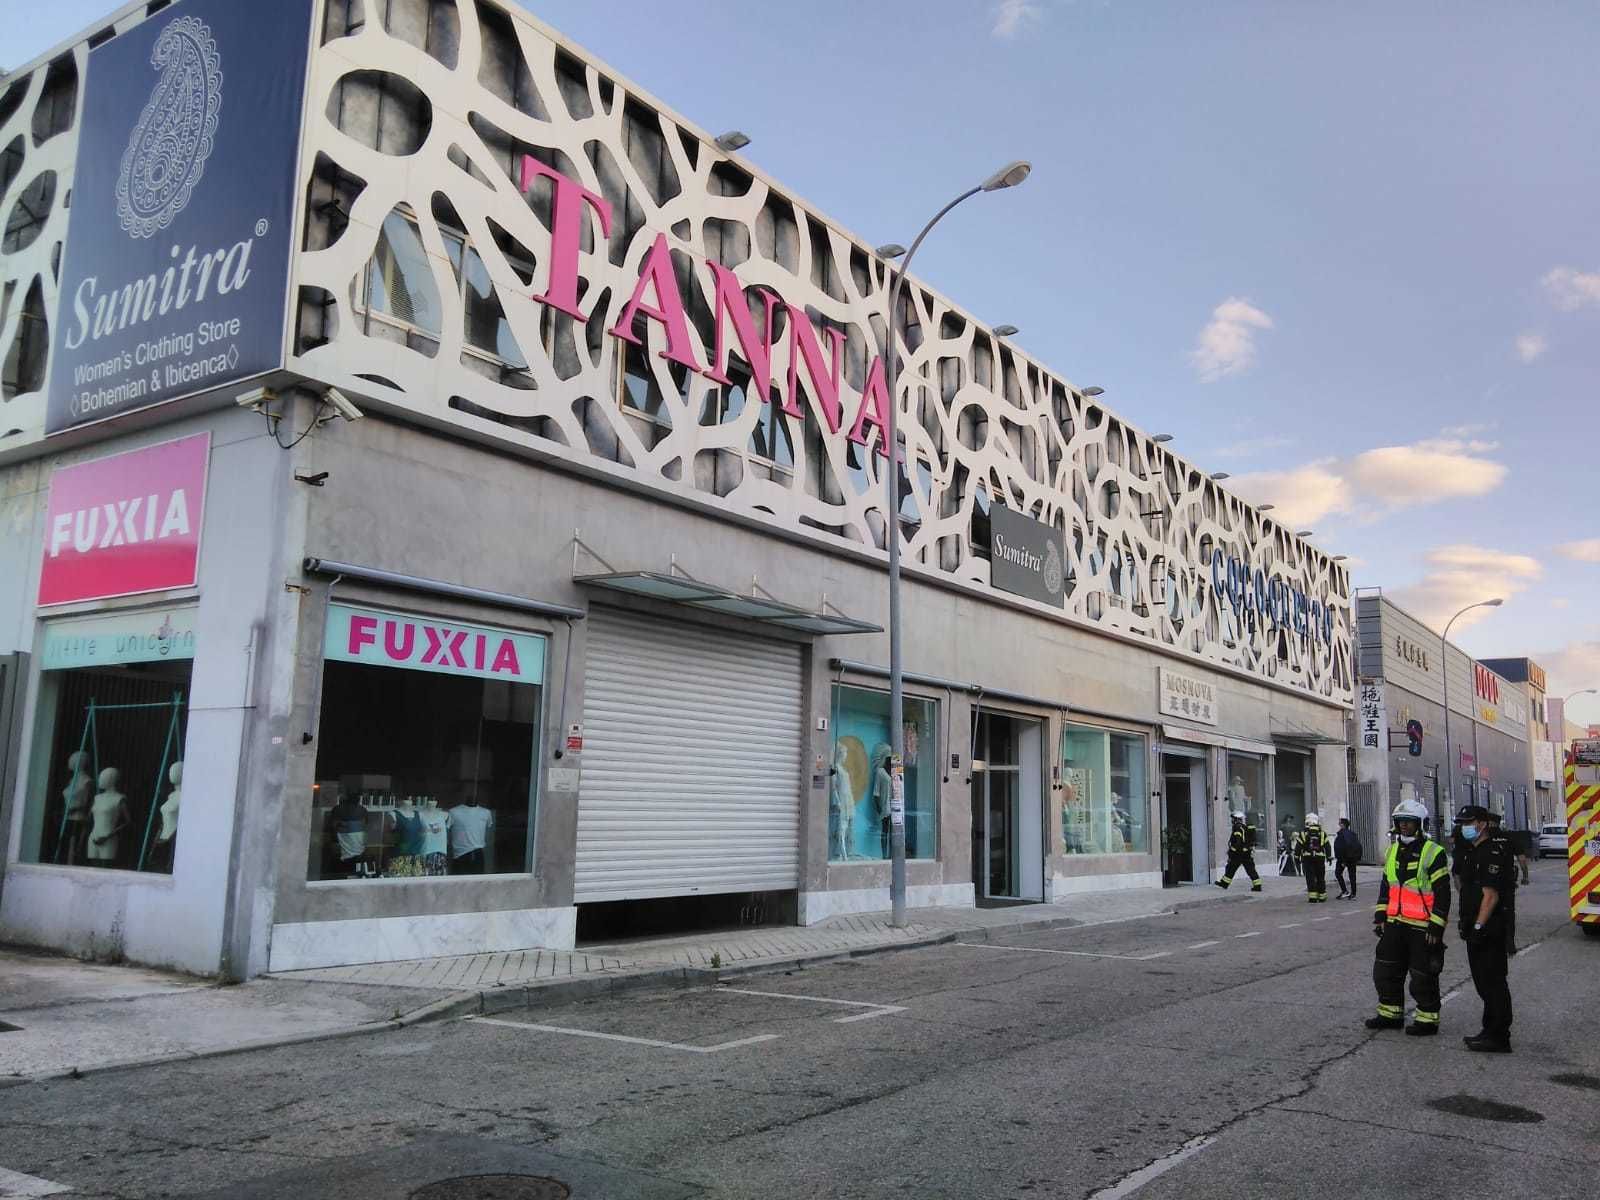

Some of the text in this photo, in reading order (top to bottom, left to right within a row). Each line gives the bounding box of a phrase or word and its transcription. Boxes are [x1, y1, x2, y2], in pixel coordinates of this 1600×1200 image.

[520, 154, 896, 463] TANNA
[74, 317, 241, 386] Women's Clothing Store
[80, 352, 227, 415] Bohemian & Ibicenca
[994, 533, 1041, 572] Sumitra
